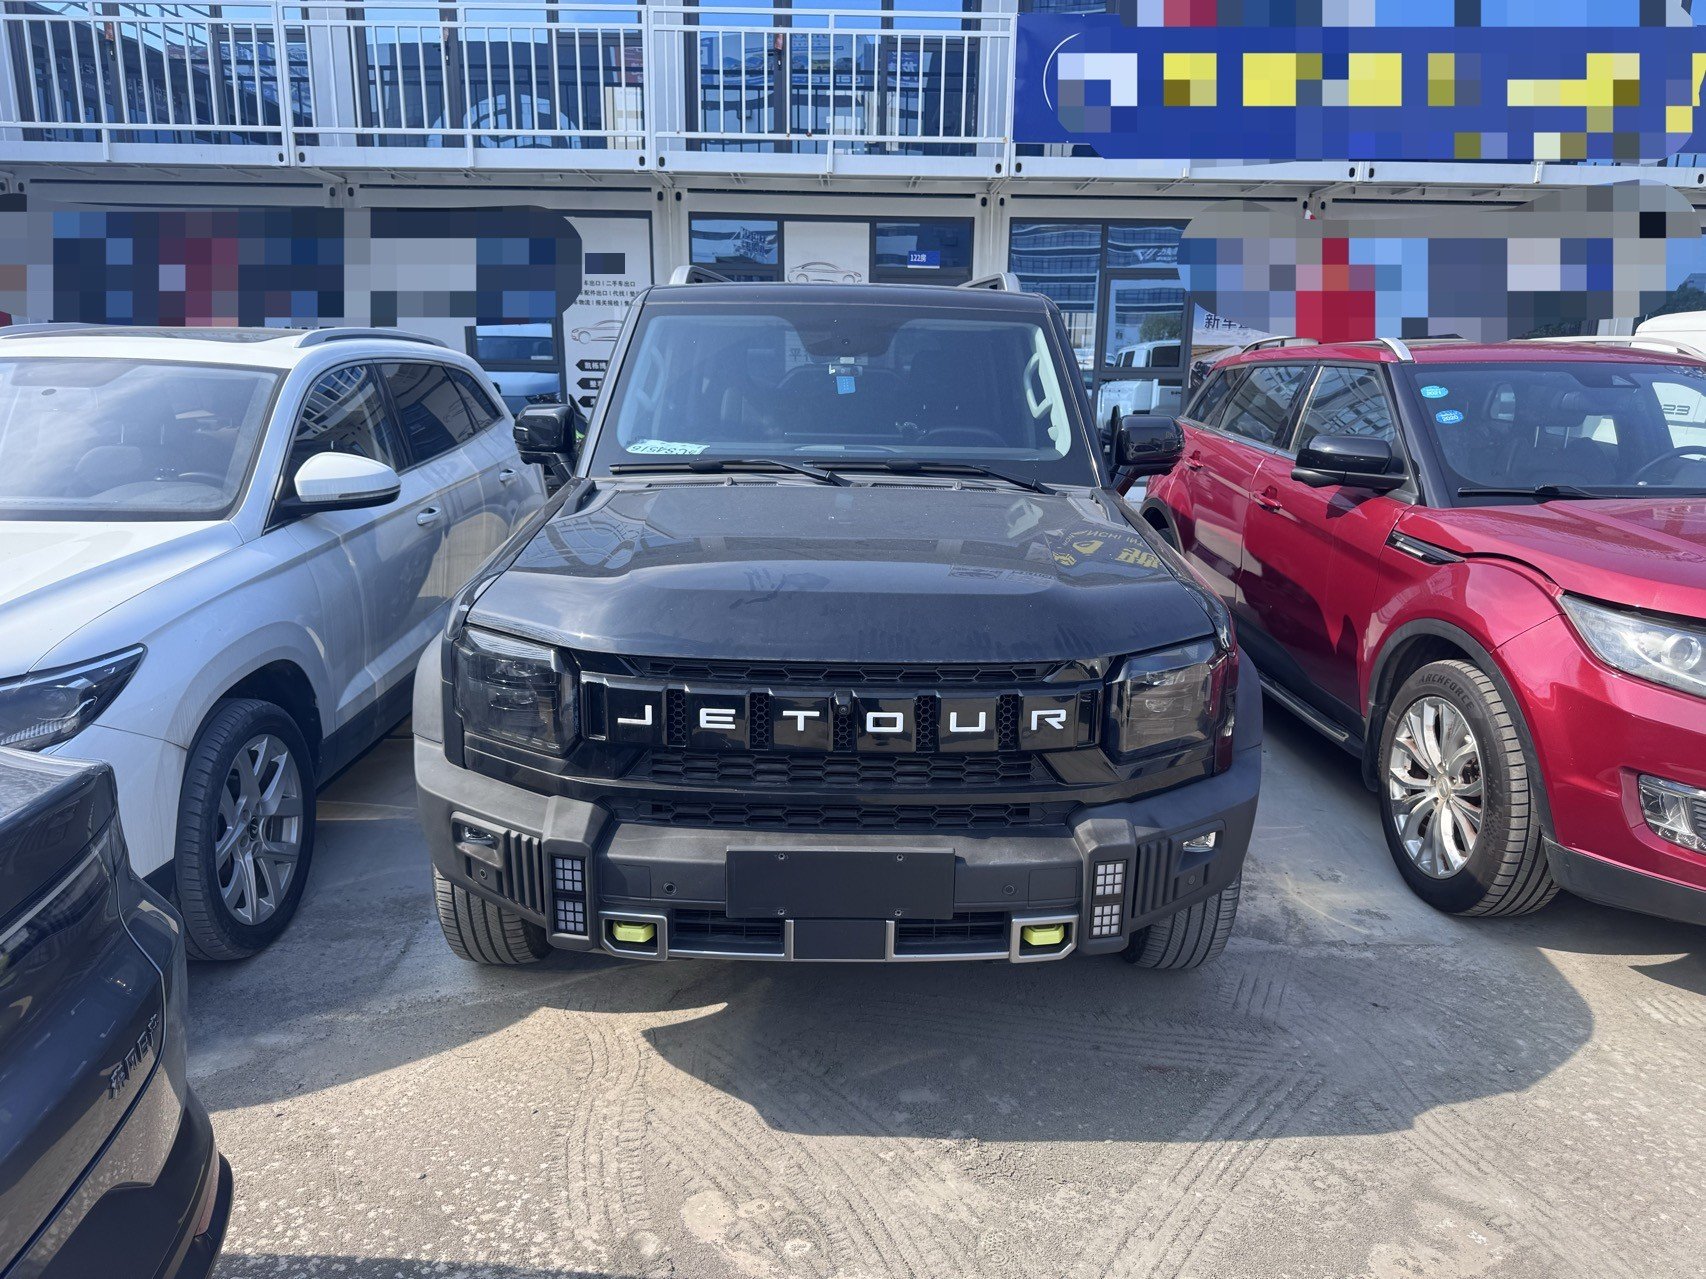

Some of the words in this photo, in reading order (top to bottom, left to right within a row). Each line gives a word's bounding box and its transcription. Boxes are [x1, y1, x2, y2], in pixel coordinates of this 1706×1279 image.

[910, 253, 927, 262] 122房
[1204, 314, 1248, 330] 新车
[1421, 673, 1475, 711] ARCHFORCE
[617, 704, 1067, 731] JETOUR
